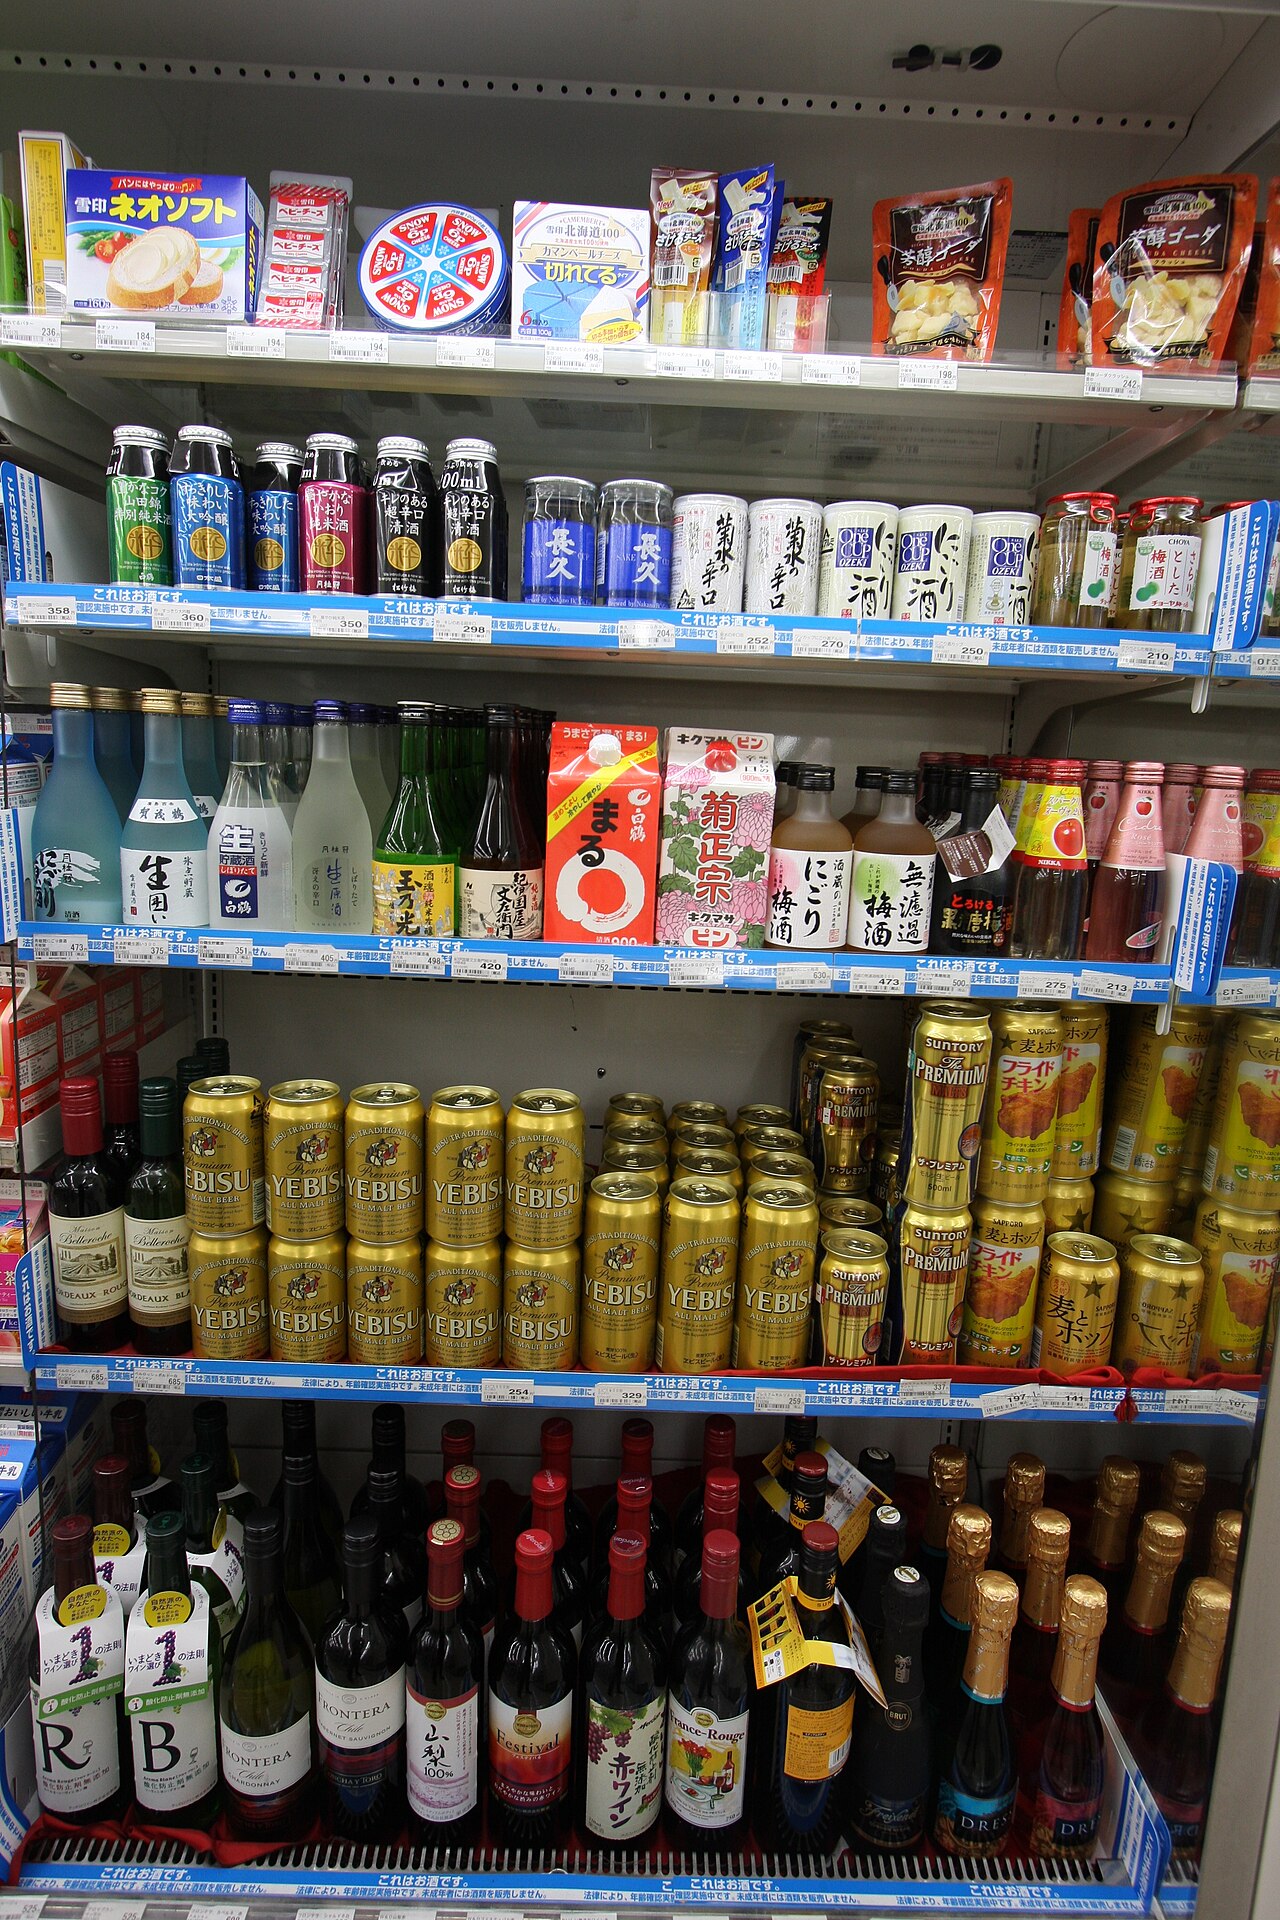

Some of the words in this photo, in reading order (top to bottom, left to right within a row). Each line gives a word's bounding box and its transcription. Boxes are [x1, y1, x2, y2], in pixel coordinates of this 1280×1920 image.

[74, 196, 107, 214] 雪印
[109, 193, 237, 224] ネオソフト
[399, 215, 430, 232] SNOW
[452, 218, 482, 237] SNOW
[274, 242, 320, 251] ベビーチーズ
[656, 233, 705, 247] さけるチーズ
[543, 246, 621, 260] カマンベールチーズ
[774, 241, 821, 253] さけるチーズ
[271, 274, 317, 284] ベビーチーズ
[544, 262, 617, 284] 切れてる
[41, 328, 56, 337] 236
[136, 332, 150, 341] 184
[267, 338, 281, 347] 194
[370, 343, 383, 351] 194
[476, 348, 491, 357] 378
[584, 353, 599, 361] 498
[697, 359, 710, 367] 110
[764, 362, 777, 371] 110
[842, 366, 855, 374] 110
[939, 370, 952, 379] 198
[1123, 380, 1137, 388] 242
[125, 497, 162, 509] 山田錦
[380, 494, 429, 509] キレのある
[252, 511, 287, 521] 味わい
[313, 502, 345, 517] かおり
[384, 507, 424, 520] 超辛口
[114, 508, 172, 526] 特別純米酒
[252, 522, 288, 536] 大吟醸
[309, 517, 349, 532] 純米酒
[389, 522, 420, 536] 清酒
[839, 529, 870, 546] One
[1168, 538, 1191, 546] CHOYA
[991, 538, 1022, 556] One
[545, 528, 575, 580] 長久
[632, 532, 661, 584] 長久
[839, 558, 868, 568] OZEKI
[1149, 549, 1167, 581] 梅酒
[992, 566, 1020, 577] OZEKI
[1167, 550, 1183, 596] とした
[1187, 551, 1197, 598] さらり
[848, 573, 878, 617] 酒
[47, 607, 70, 615] 358
[182, 613, 204, 622] 360
[210, 610, 272, 620] を販売しません。
[340, 620, 362, 628] 350
[463, 625, 485, 633] 298
[657, 629, 670, 638] 204
[946, 626, 1040, 641] これはお酒です。
[747, 636, 769, 645] 252
[821, 640, 843, 648] 270
[961, 647, 984, 655] 250
[991, 642, 1118, 656] 未成年者には酒類を販売しません。
[1147, 652, 1169, 660] 210
[737, 736, 763, 749] ピン
[629, 808, 647, 842] 白鶴
[219, 824, 255, 854] 生
[578, 799, 618, 868] まる
[259, 832, 268, 877] きりっと新鮮
[322, 845, 349, 853] 月桂冠
[695, 790, 739, 906] 菊正宗
[219, 854, 255, 866] 貯蔵酒
[220, 867, 257, 875] しぼりたて
[832, 859, 845, 900] 酒蔵の
[396, 870, 423, 936] 玉乃光
[512, 872, 528, 926] 紀伊国屋
[803, 857, 828, 937] にごり
[897, 861, 926, 945] 無濾過
[951, 894, 994, 910] とろける
[225, 901, 251, 915] 白鶴
[497, 887, 513, 939] 文左衛門
[687, 912, 735, 924] キクマサ
[771, 888, 797, 944] 梅酒
[864, 891, 897, 947] 梅酒
[693, 929, 730, 947] ピン
[71, 943, 84, 951] 473
[151, 947, 164, 956] 375
[235, 946, 248, 955] 351
[320, 954, 334, 962] 405
[427, 957, 441, 965] 498
[480, 963, 501, 971] 420
[596, 963, 609, 971] 752
[706, 967, 718, 975] 754
[953, 979, 966, 987] 500
[1045, 981, 1066, 989] 275
[925, 1037, 984, 1053] SUNTORY
[915, 1059, 986, 1086] PREMIUM
[1002, 1059, 1055, 1078] フライド
[1001, 1076, 1047, 1094] チキン
[917, 1158, 966, 1171] ザ・プレミアム
[992, 1160, 1051, 1173] ファミマキッチン
[185, 1168, 250, 1193] EBISU
[346, 1173, 423, 1202] YEBISU
[432, 1178, 502, 1205] YEBISU
[928, 1184, 952, 1192] 500ml
[525, 1210, 549, 1219] MALT
[993, 1219, 1023, 1227] SAPPORO
[60, 1232, 112, 1245] Belleroche
[915, 1228, 967, 1240] SUNTORY
[986, 1226, 1042, 1244] 麦とホップ
[904, 1247, 970, 1272] PREMIUM
[970, 1243, 1022, 1266] フライド
[833, 1270, 882, 1281] SUNTORY
[825, 1284, 885, 1306] PREMIUM
[909, 1341, 953, 1351] ザ・プレミアム
[92, 1373, 104, 1381] 685
[168, 1378, 181, 1386] 685
[376, 1369, 461, 1382] これはお酒です。
[1007, 1394, 1025, 1402] 197
[113, 1583, 138, 1592] の法則
[68, 1590, 100, 1602] 自然派の
[151, 1597, 183, 1606] 自然派の
[151, 1603, 186, 1611] あなたへ。
[43, 1650, 78, 1667] いまどき
[128, 1651, 163, 1665] いまどき
[178, 1648, 205, 1661] の法則
[43, 1659, 79, 1673] ワイン選び
[146, 1688, 206, 1707] 酸化防止剤無添加
[318, 1692, 391, 1720] FRONTERA
[889, 1711, 907, 1720] BRUT
[670, 1709, 745, 1744] France-Rouge
[36, 1720, 91, 1772] R
[138, 1720, 181, 1773] B
[421, 1724, 450, 1768] 山梨
[496, 1728, 560, 1754] Festival
[424, 1766, 454, 1779] 100%
[608, 1751, 636, 1829] 赤ワイン
[690, 1878, 780, 1891] これはお酒です。
[22, 1904, 37, 1914] 525
